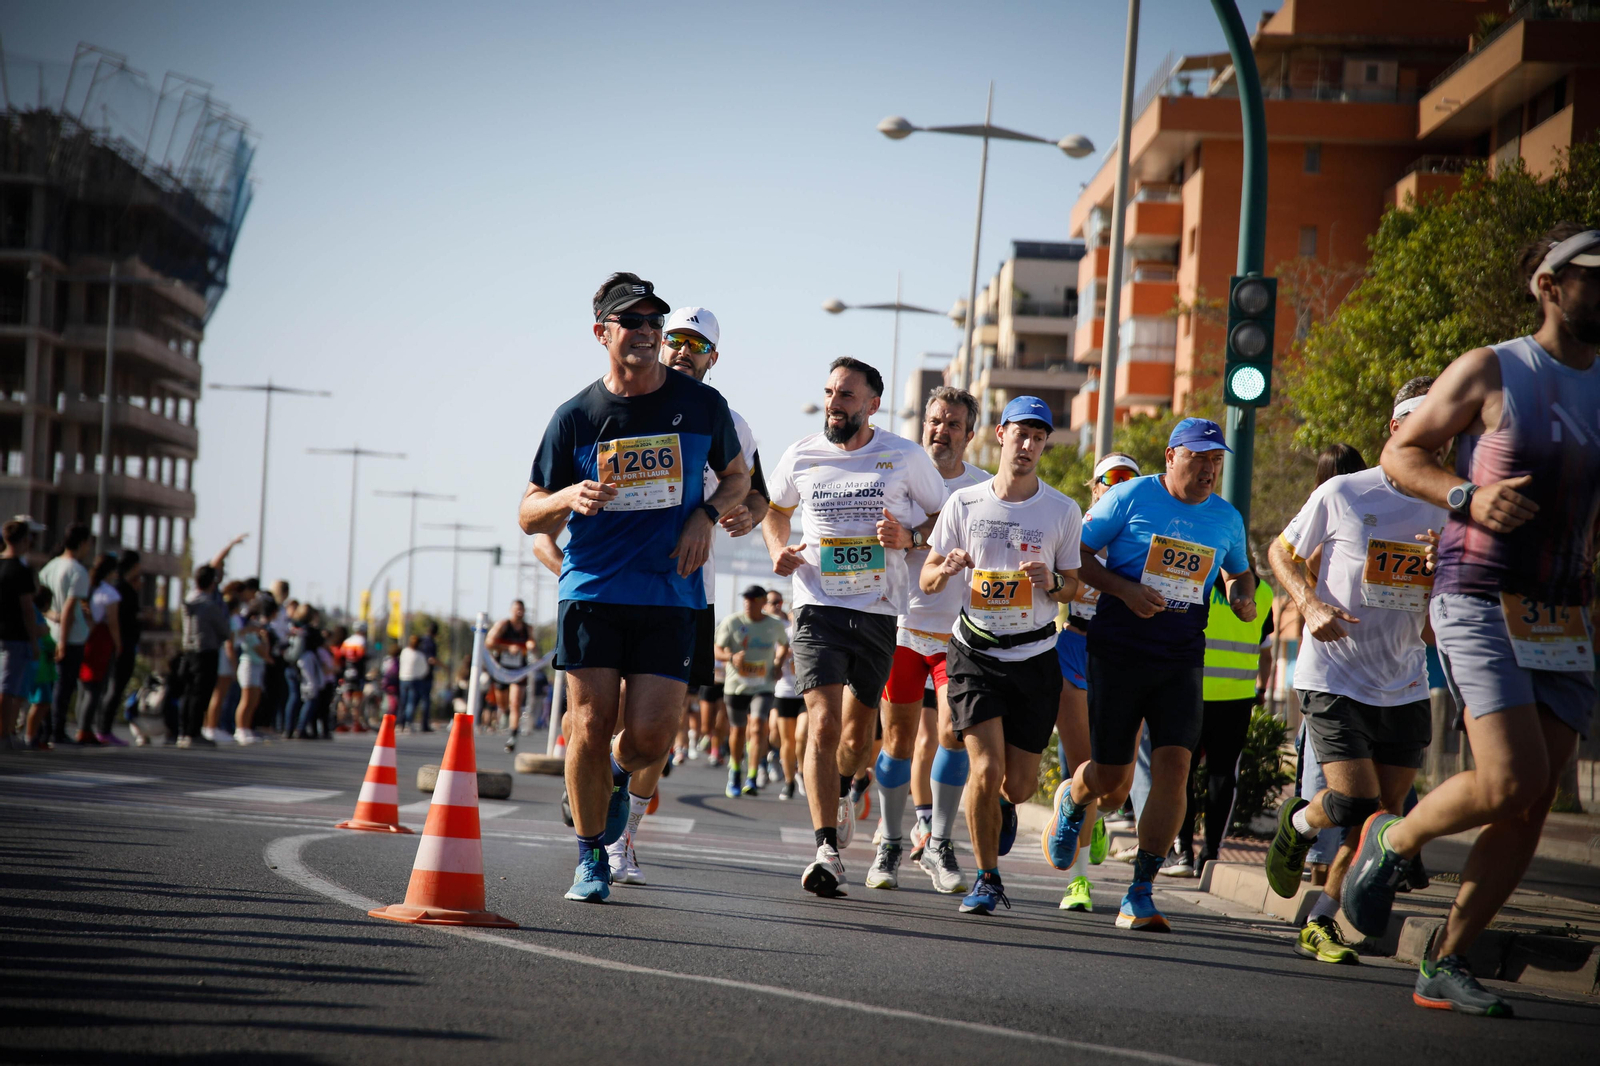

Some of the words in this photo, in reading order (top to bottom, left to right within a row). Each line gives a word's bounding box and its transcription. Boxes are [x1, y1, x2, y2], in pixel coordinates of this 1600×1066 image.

[607, 447, 674, 474] 1266
[648, 470, 669, 478] LAURA
[812, 482, 842, 490] Medio
[844, 481, 886, 489] Maratón
[812, 490, 853, 499] Almería
[854, 488, 885, 498] 2024
[986, 519, 1020, 527] TotalEnergies
[1012, 528, 1044, 538] maratón
[1009, 535, 1042, 544] GRANADA
[833, 546, 872, 565] 565
[1162, 548, 1201, 572] 928
[1166, 567, 1191, 577] AGUSTIN
[981, 581, 1019, 599] 927
